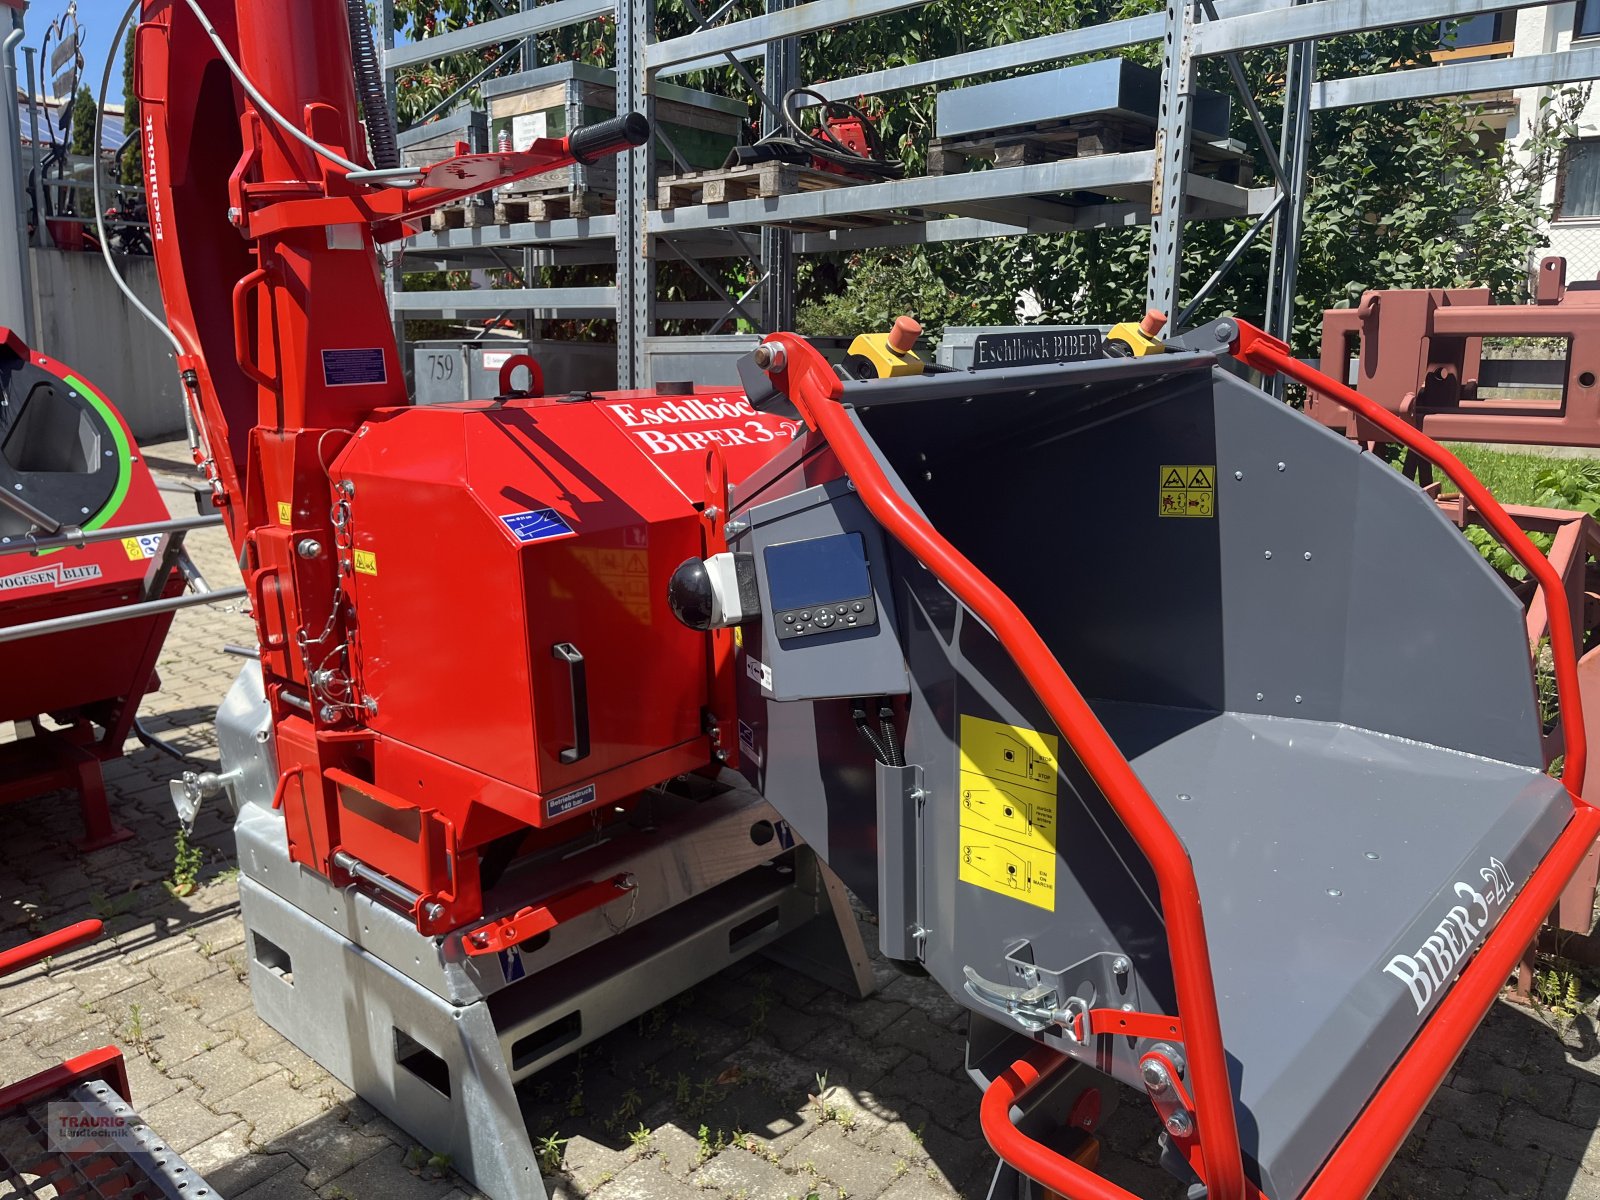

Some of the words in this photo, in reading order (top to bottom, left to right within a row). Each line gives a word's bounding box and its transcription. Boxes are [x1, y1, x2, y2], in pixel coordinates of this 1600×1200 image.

[145, 114, 163, 241] Eschlböck
[978, 337, 1050, 364] Eschlböck
[1054, 334, 1097, 358] BIBER
[427, 354, 454, 380] 759
[64, 565, 101, 579] BLITZ
[549, 787, 593, 808] Betriebsdruck
[572, 798, 584, 806] bar
